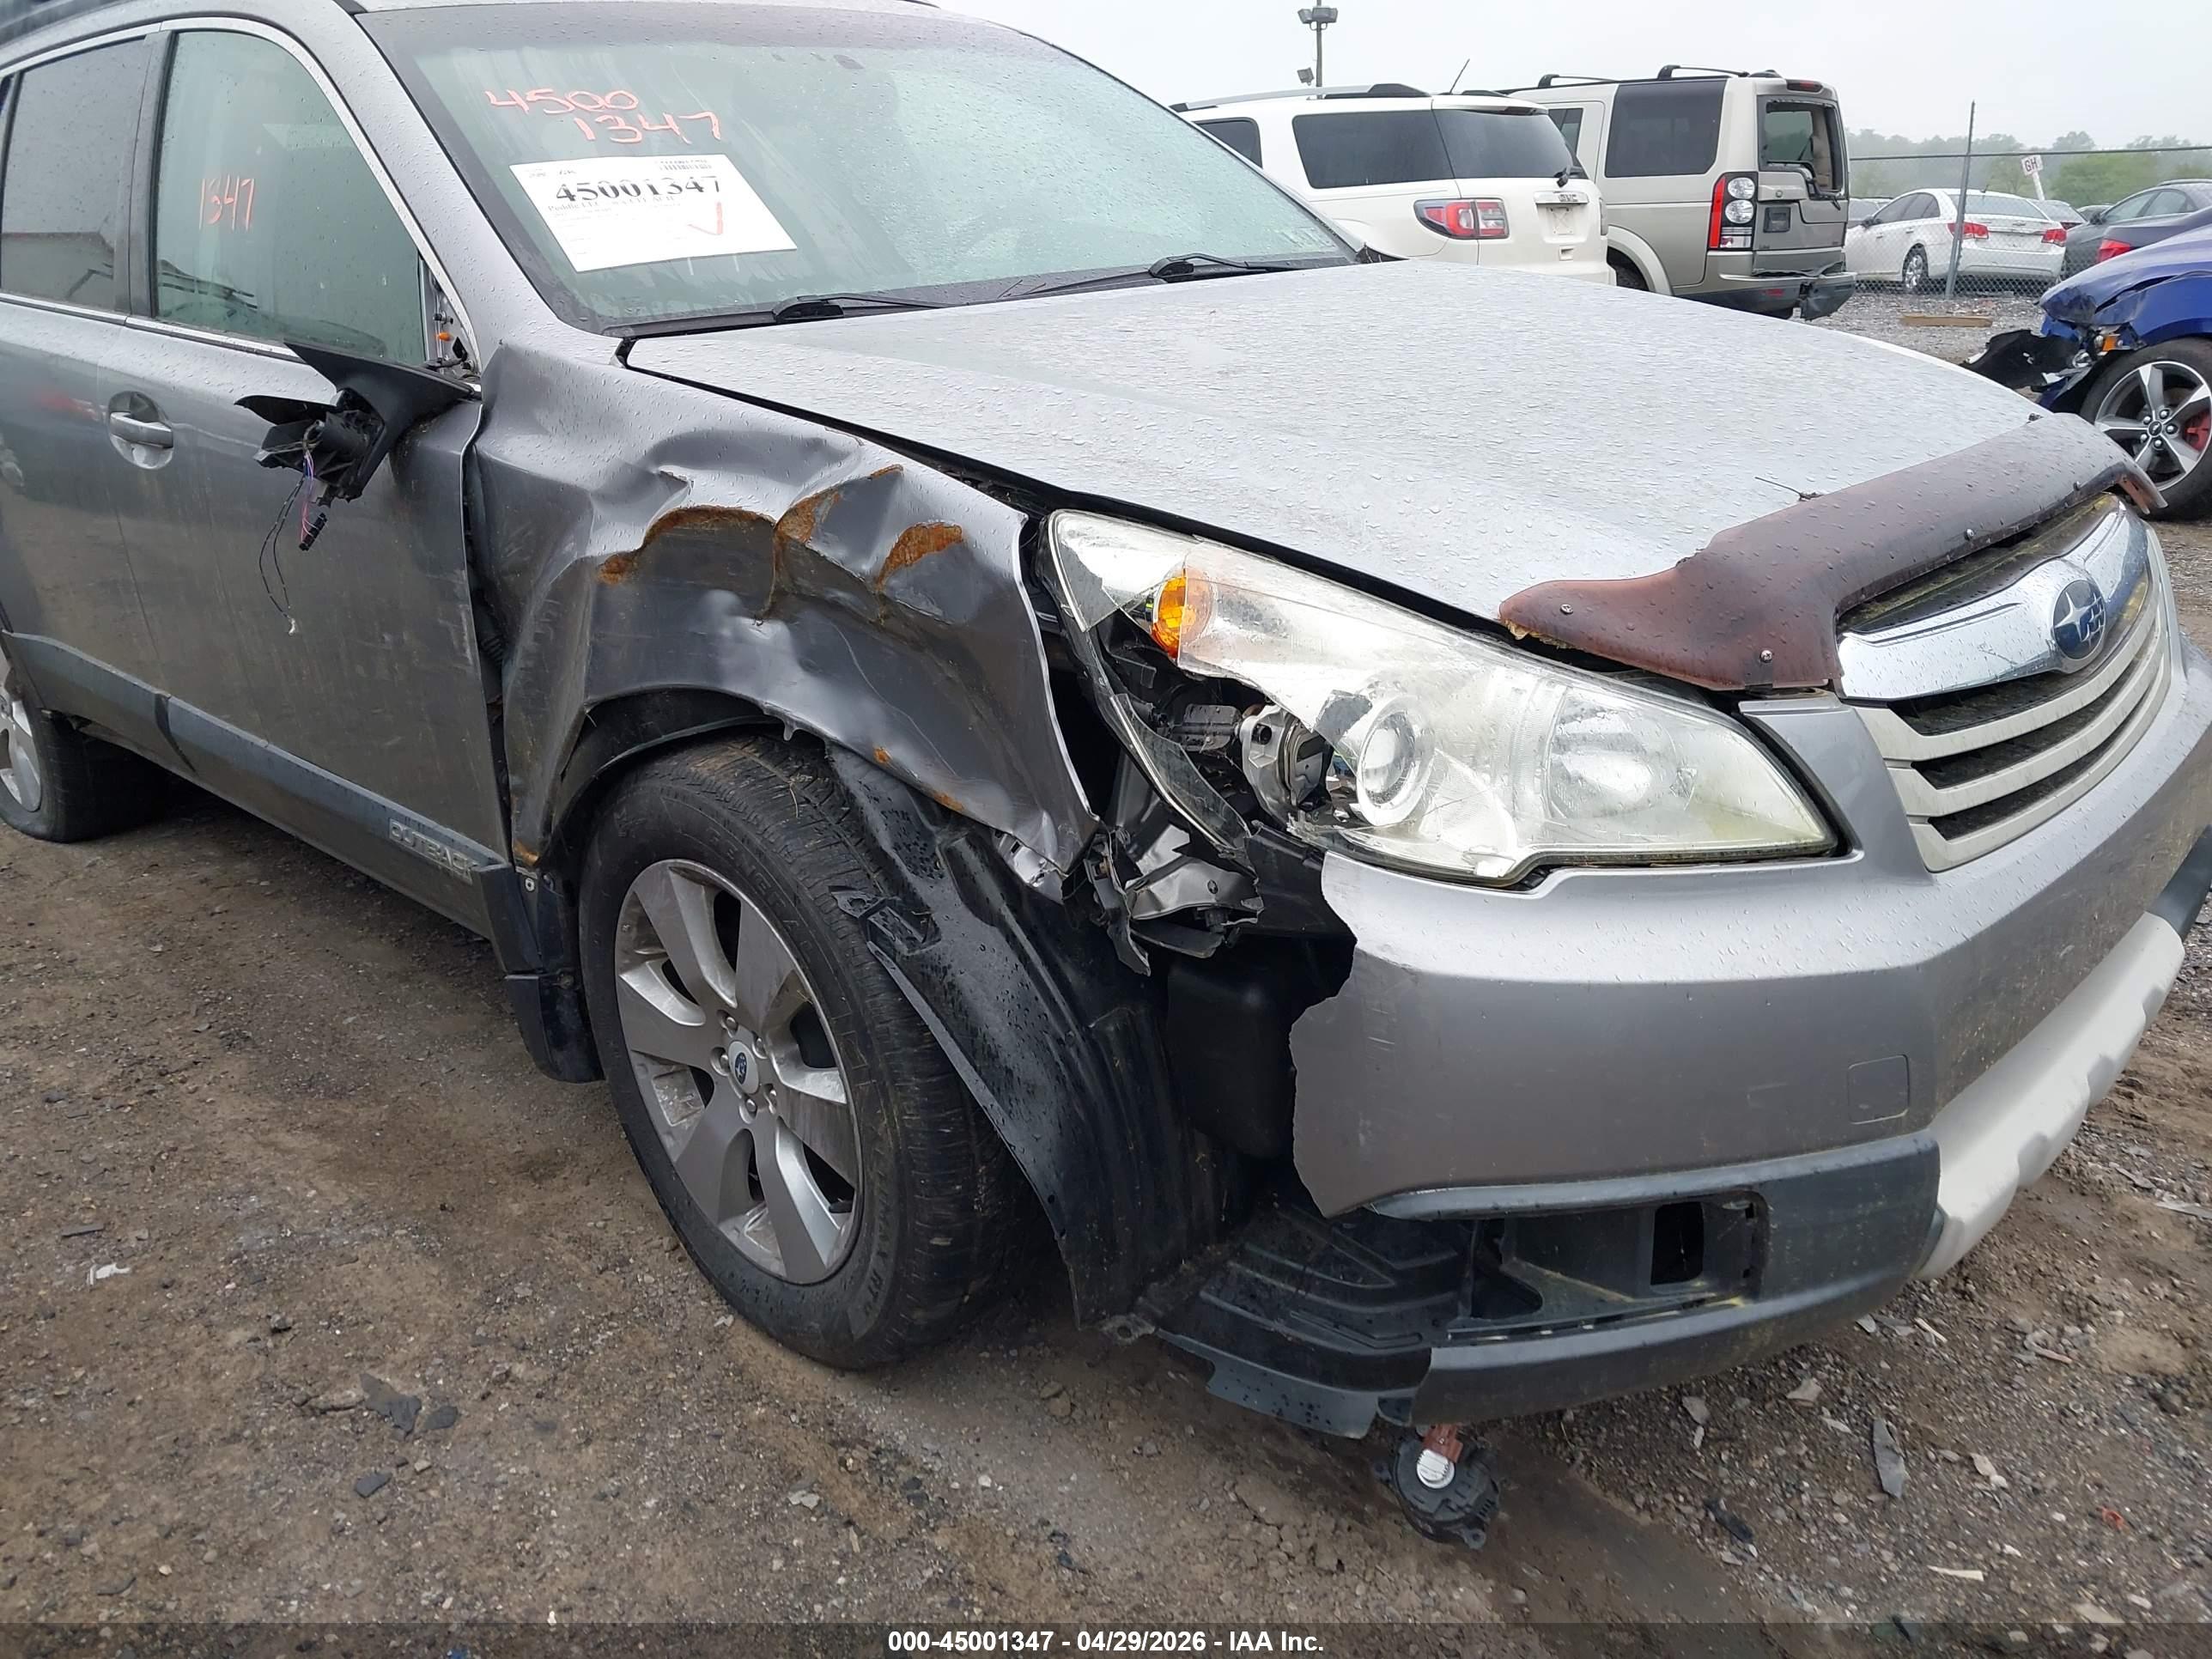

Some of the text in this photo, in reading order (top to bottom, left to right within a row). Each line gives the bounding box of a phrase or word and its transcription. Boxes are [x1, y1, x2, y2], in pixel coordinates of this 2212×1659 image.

[485, 89, 639, 114] 4500
[574, 111, 720, 144] 1347
[2024, 157, 2039, 173] GH
[198, 173, 255, 231] 1347
[556, 175, 720, 202] 45001347
[389, 819, 478, 884] OUTBACK
